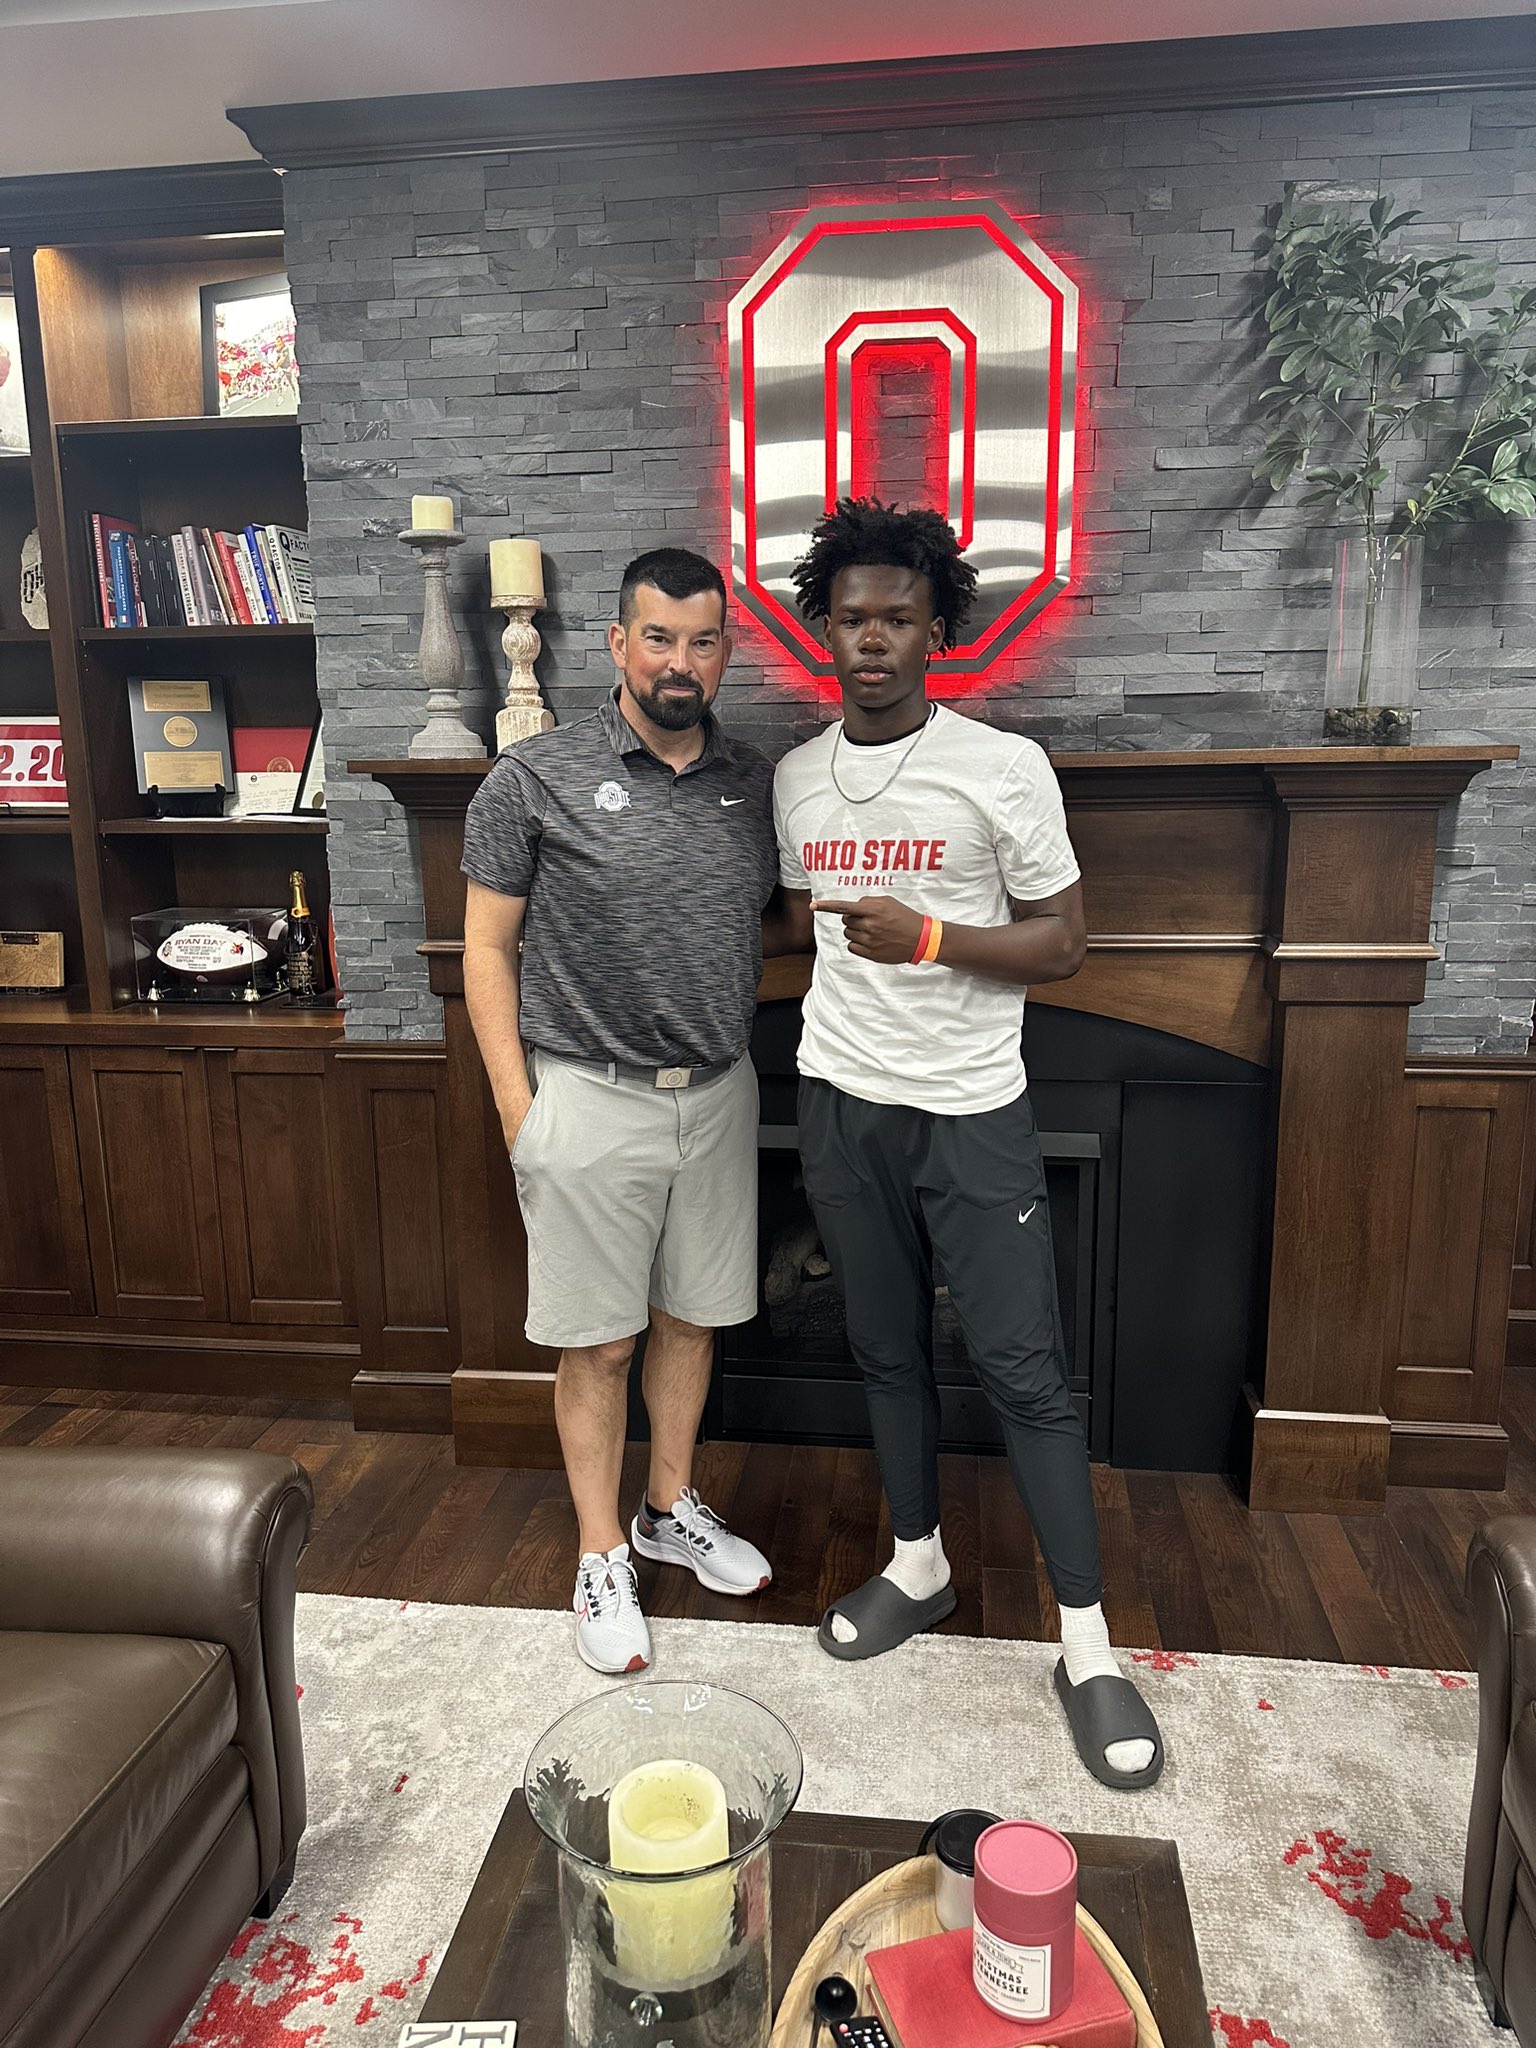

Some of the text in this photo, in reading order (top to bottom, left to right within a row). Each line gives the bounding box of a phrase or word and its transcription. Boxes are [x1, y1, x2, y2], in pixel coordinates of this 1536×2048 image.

[728, 199, 1079, 675] O
[250, 550, 259, 567] TRUE
[255, 568, 265, 591] NORTH
[270, 544, 281, 570] FACTOR
[803, 839, 947, 872] OHIO STATE
[837, 875, 894, 887] FOOTBALL
[976, 1957, 1029, 1995] TENNESSEE
